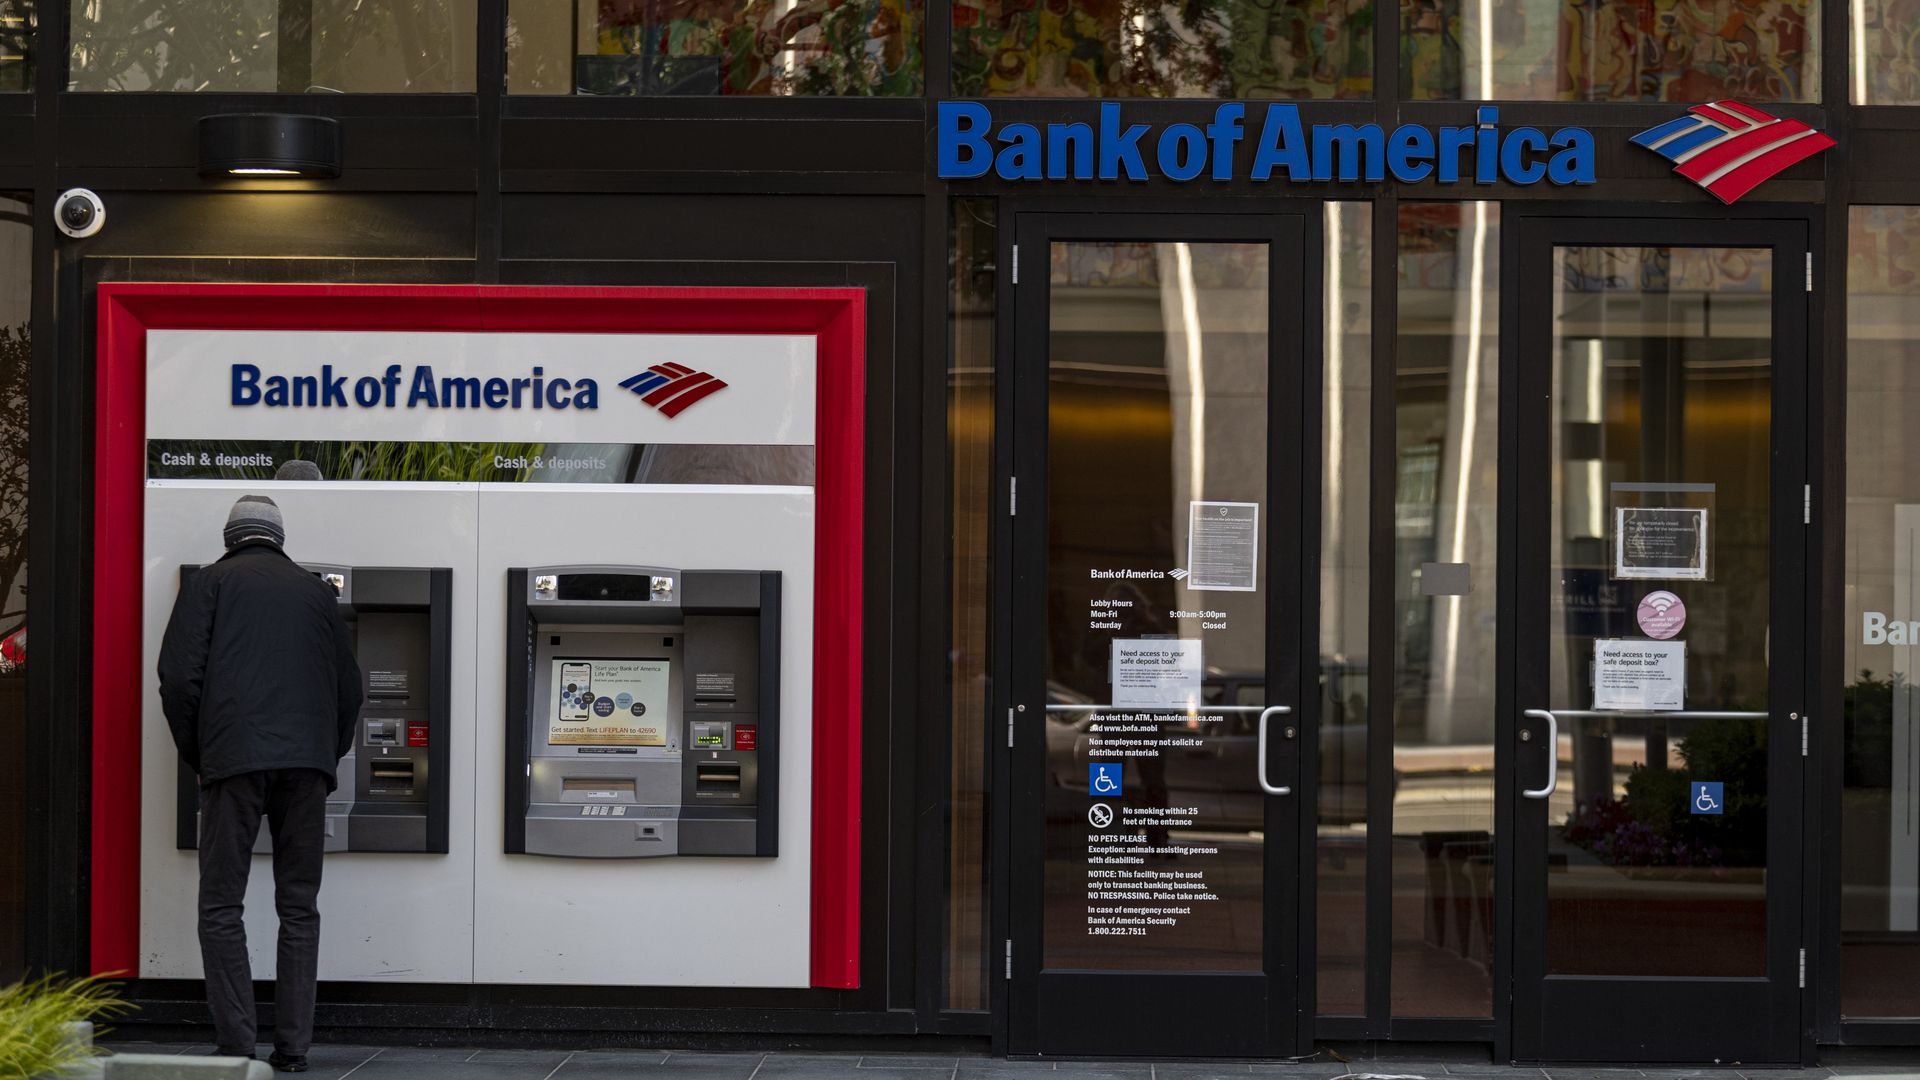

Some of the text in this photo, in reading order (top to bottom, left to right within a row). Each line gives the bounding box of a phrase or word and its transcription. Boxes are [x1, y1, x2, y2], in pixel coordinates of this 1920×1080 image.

[938, 101, 1597, 185] Bank of America
[231, 364, 599, 410] Bank of America
[161, 452, 273, 468] Cash & deposits
[494, 456, 606, 471] Cash & deposits
[1091, 569, 1164, 579] Bank of America
[1091, 600, 1111, 609] Lobby
[1170, 611, 1226, 620] 9:00am-5:00pm
[1090, 622, 1226, 630] Saturday Closed
[1089, 714, 1105, 722] Also
[1106, 714, 1121, 722] visit
[1122, 714, 1133, 722] the
[1135, 714, 1152, 723] ATM,
[1089, 738, 1103, 746] Non
[1105, 739, 1142, 747] employees
[1143, 740, 1158, 748] may
[1172, 739, 1194, 747] solicit
[1089, 749, 1159, 757] distribute materials
[1123, 807, 1132, 815] No
[1134, 808, 1164, 817] smoking
[1123, 818, 1137, 826] feet
[1139, 818, 1147, 826] of
[1147, 818, 1159, 826] the
[1089, 835, 1147, 843] NO PETS PLEASE
[1089, 846, 1125, 855] Exception:
[1127, 846, 1155, 854] animals
[1156, 846, 1188, 856] assisting
[1134, 871, 1158, 880] facility
[1088, 882, 1103, 890] only
[1144, 882, 1173, 891] banking
[1174, 882, 1207, 890] business.
[1088, 892, 1098, 900] NO
[1100, 892, 1152, 900] TRESPASSING.
[1194, 893, 1219, 901] notice.
[1088, 906, 1095, 914] In
[1114, 906, 1122, 914] of
[1123, 908, 1162, 916] emergency
[1107, 917, 1115, 925] of
[1116, 917, 1145, 925] America
[1147, 917, 1176, 926] Security
[1088, 928, 1146, 936] 1.800.222.7511
